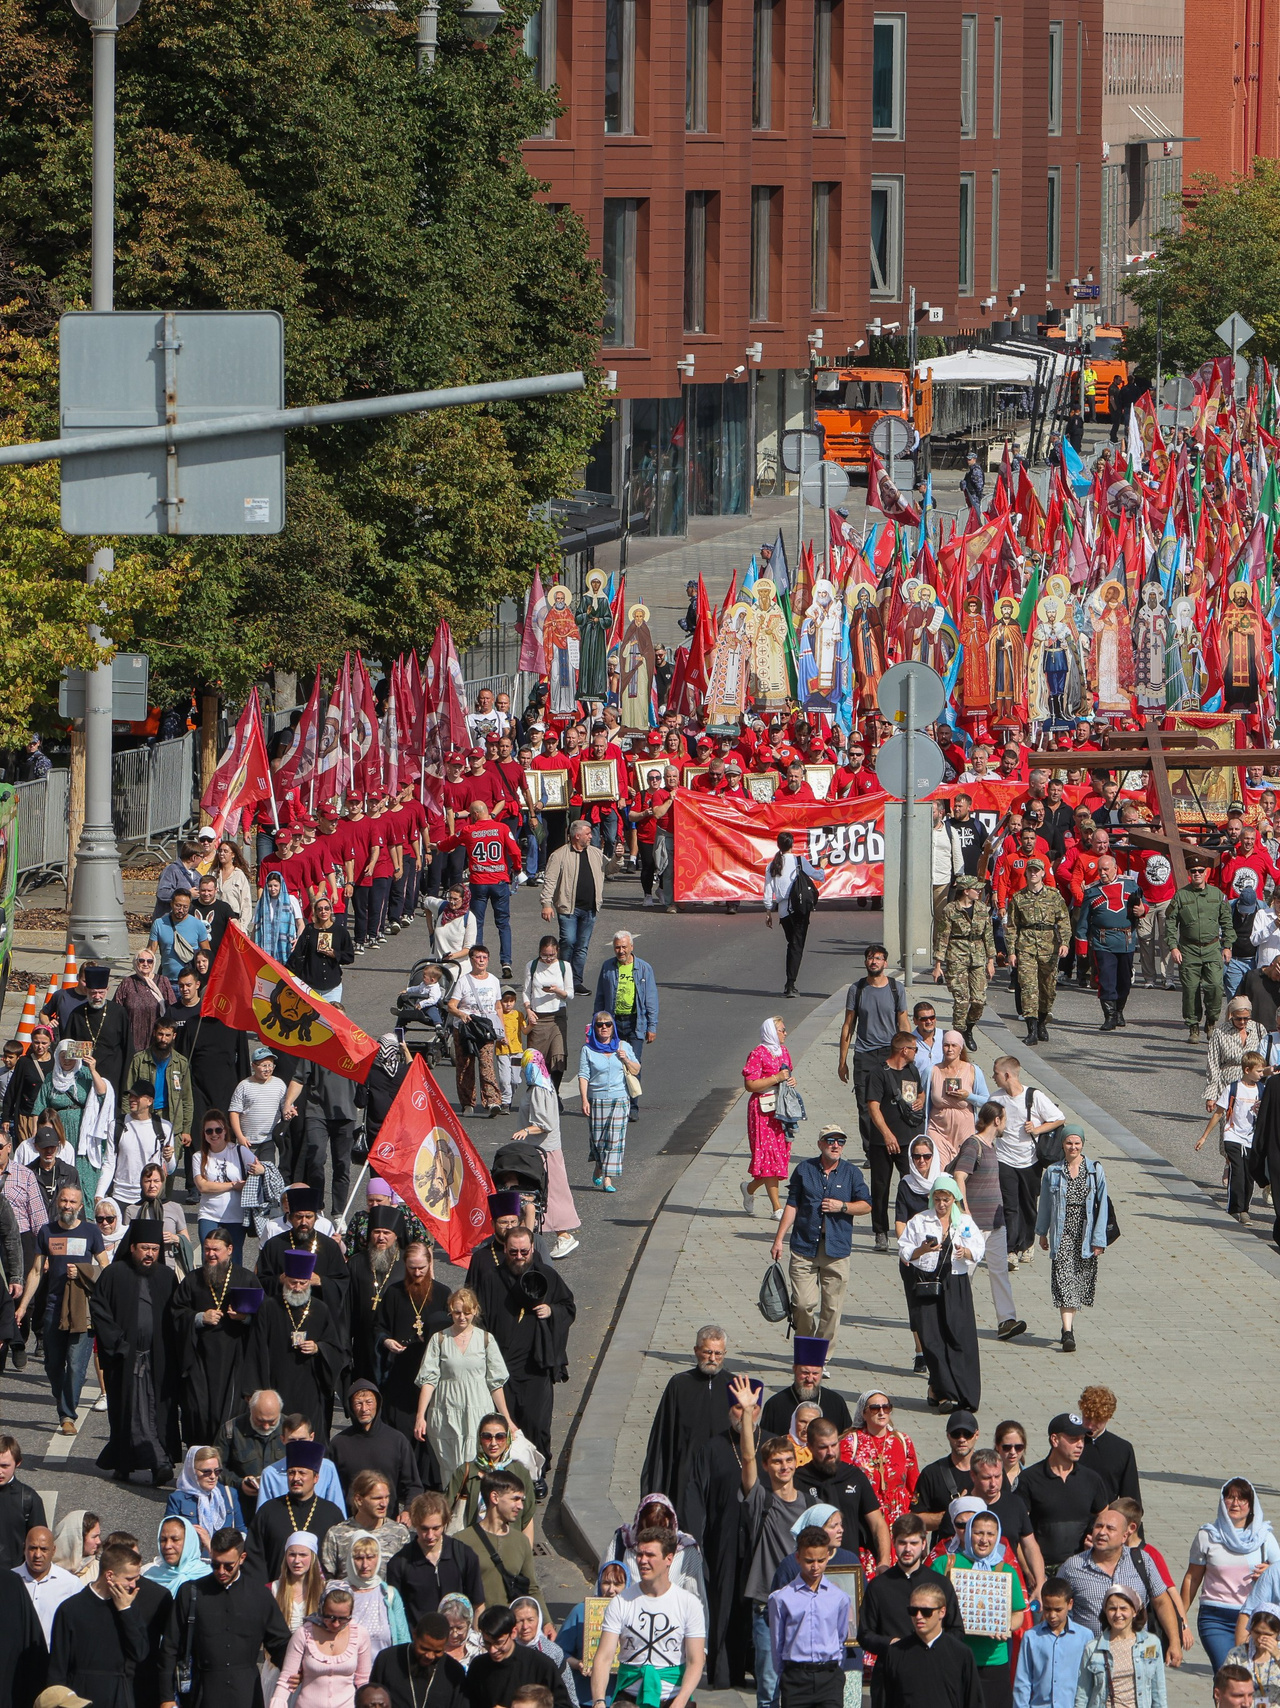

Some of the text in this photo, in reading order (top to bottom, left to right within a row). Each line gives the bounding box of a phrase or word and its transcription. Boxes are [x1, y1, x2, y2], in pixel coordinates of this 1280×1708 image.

[471, 829, 499, 839] СОРОК
[809, 821, 885, 867] РУСЬ
[472, 841, 502, 862] 40
